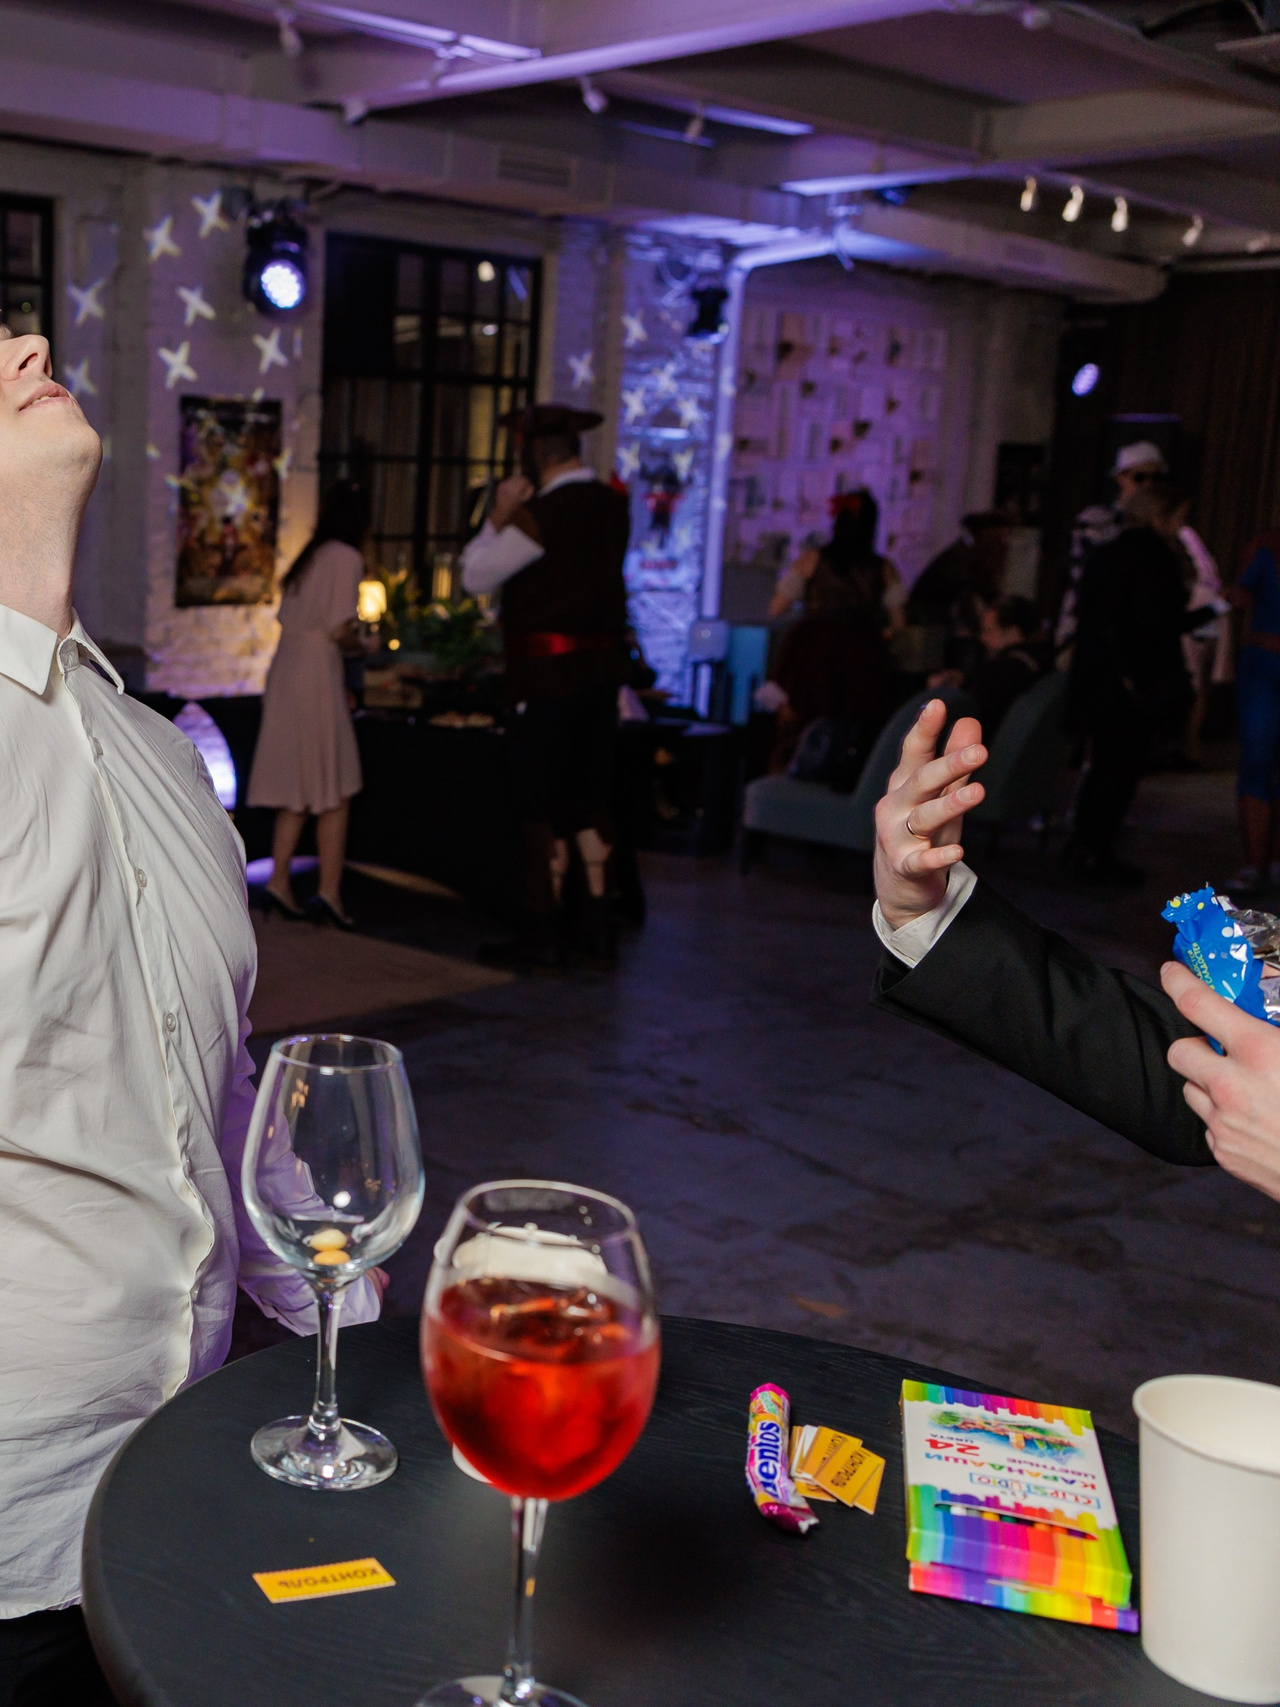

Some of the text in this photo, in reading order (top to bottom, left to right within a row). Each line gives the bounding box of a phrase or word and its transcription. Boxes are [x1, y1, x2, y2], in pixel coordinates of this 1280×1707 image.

[925, 1438, 980, 1457] 24
[930, 1433, 975, 1444] ЦВЕТА
[924, 1452, 1097, 1491] КАРАНДАШИ
[1006, 1457, 1097, 1480] ЦВЕТНЫЕ
[277, 1567, 381, 1590] КОНТРОЛЬ
